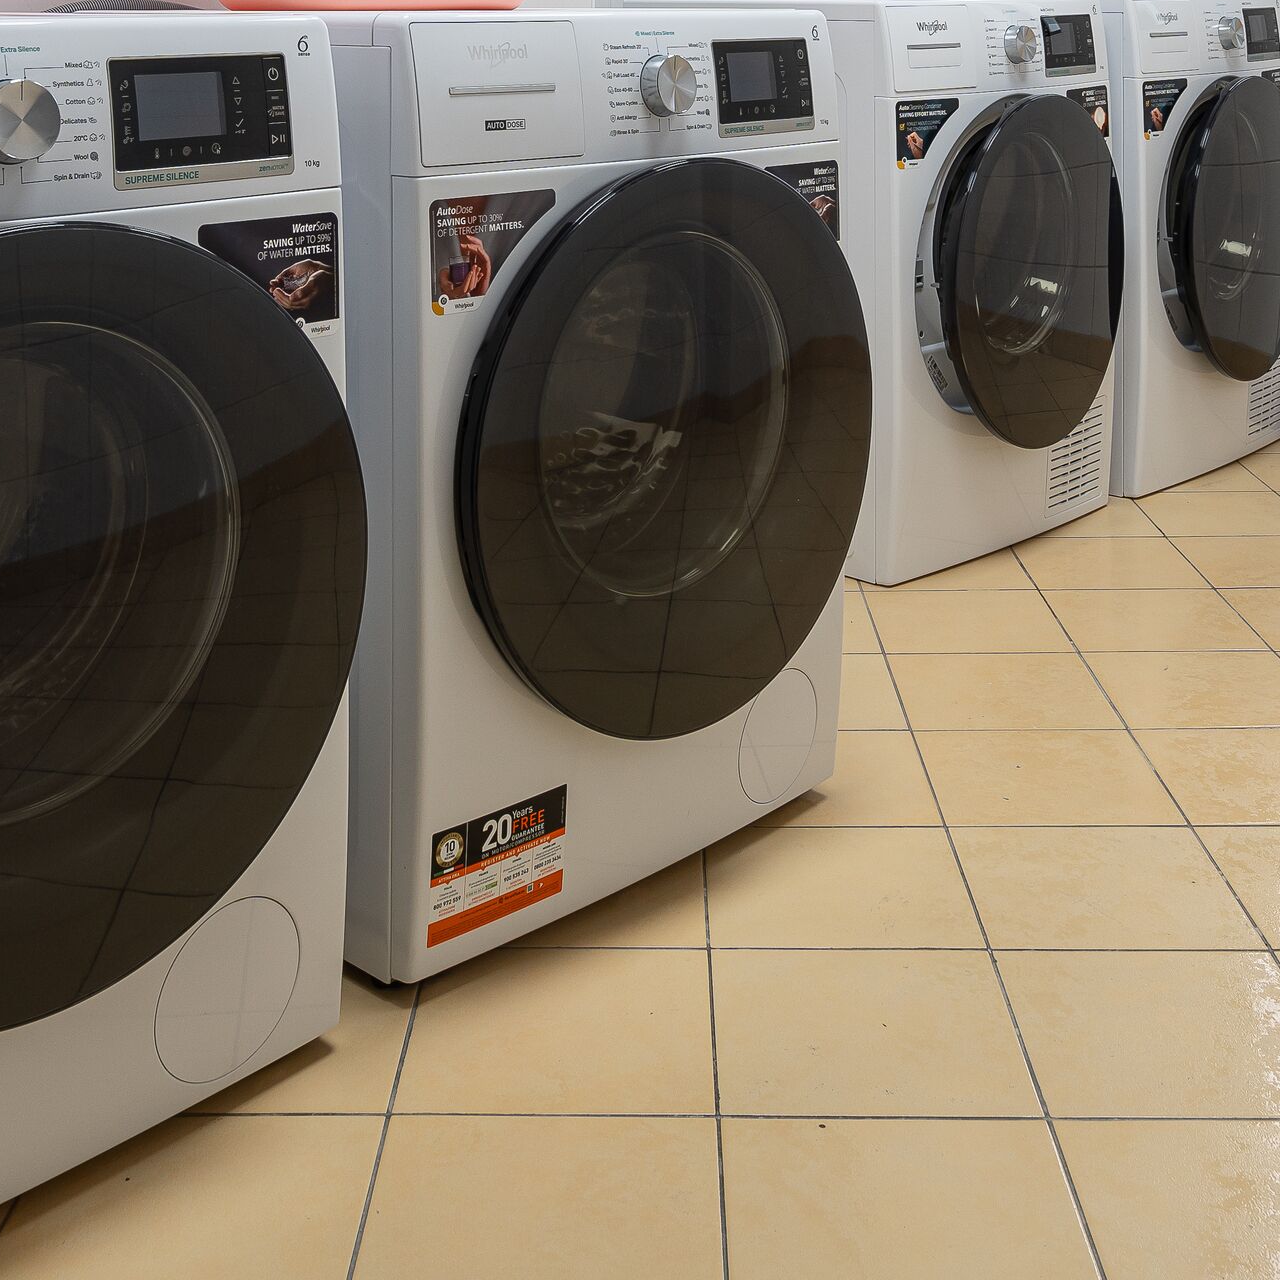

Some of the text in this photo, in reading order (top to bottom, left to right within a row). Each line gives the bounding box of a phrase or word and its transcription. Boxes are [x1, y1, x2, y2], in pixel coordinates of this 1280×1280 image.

[1157, 12, 1177, 25] Whirlpool
[917, 20, 947, 36] Whirlpool
[467, 42, 528, 68] Whirlpool
[54, 174, 67, 182] Spin
[125, 171, 199, 184] SUPREME SILENCE
[816, 184, 836, 192] MATTERS.
[437, 205, 473, 216] AutoDose
[293, 221, 332, 233] WaterSave
[437, 217, 466, 227] SAVING
[468, 216, 477, 224] UP
[479, 215, 488, 223] TO
[437, 221, 524, 237] OF DETERGENT MATTERS.
[264, 238, 293, 249] SAVING
[295, 236, 304, 245] UP
[306, 235, 316, 244] TO
[258, 245, 332, 261] OF WATER MATTERS.
[311, 325, 330, 334] Whirlpool
[512, 806, 533, 819] Years
[513, 809, 544, 834] FREE
[482, 814, 512, 852] 20
[512, 823, 544, 841] GUARANTEE
[444, 840, 455, 853] 10
